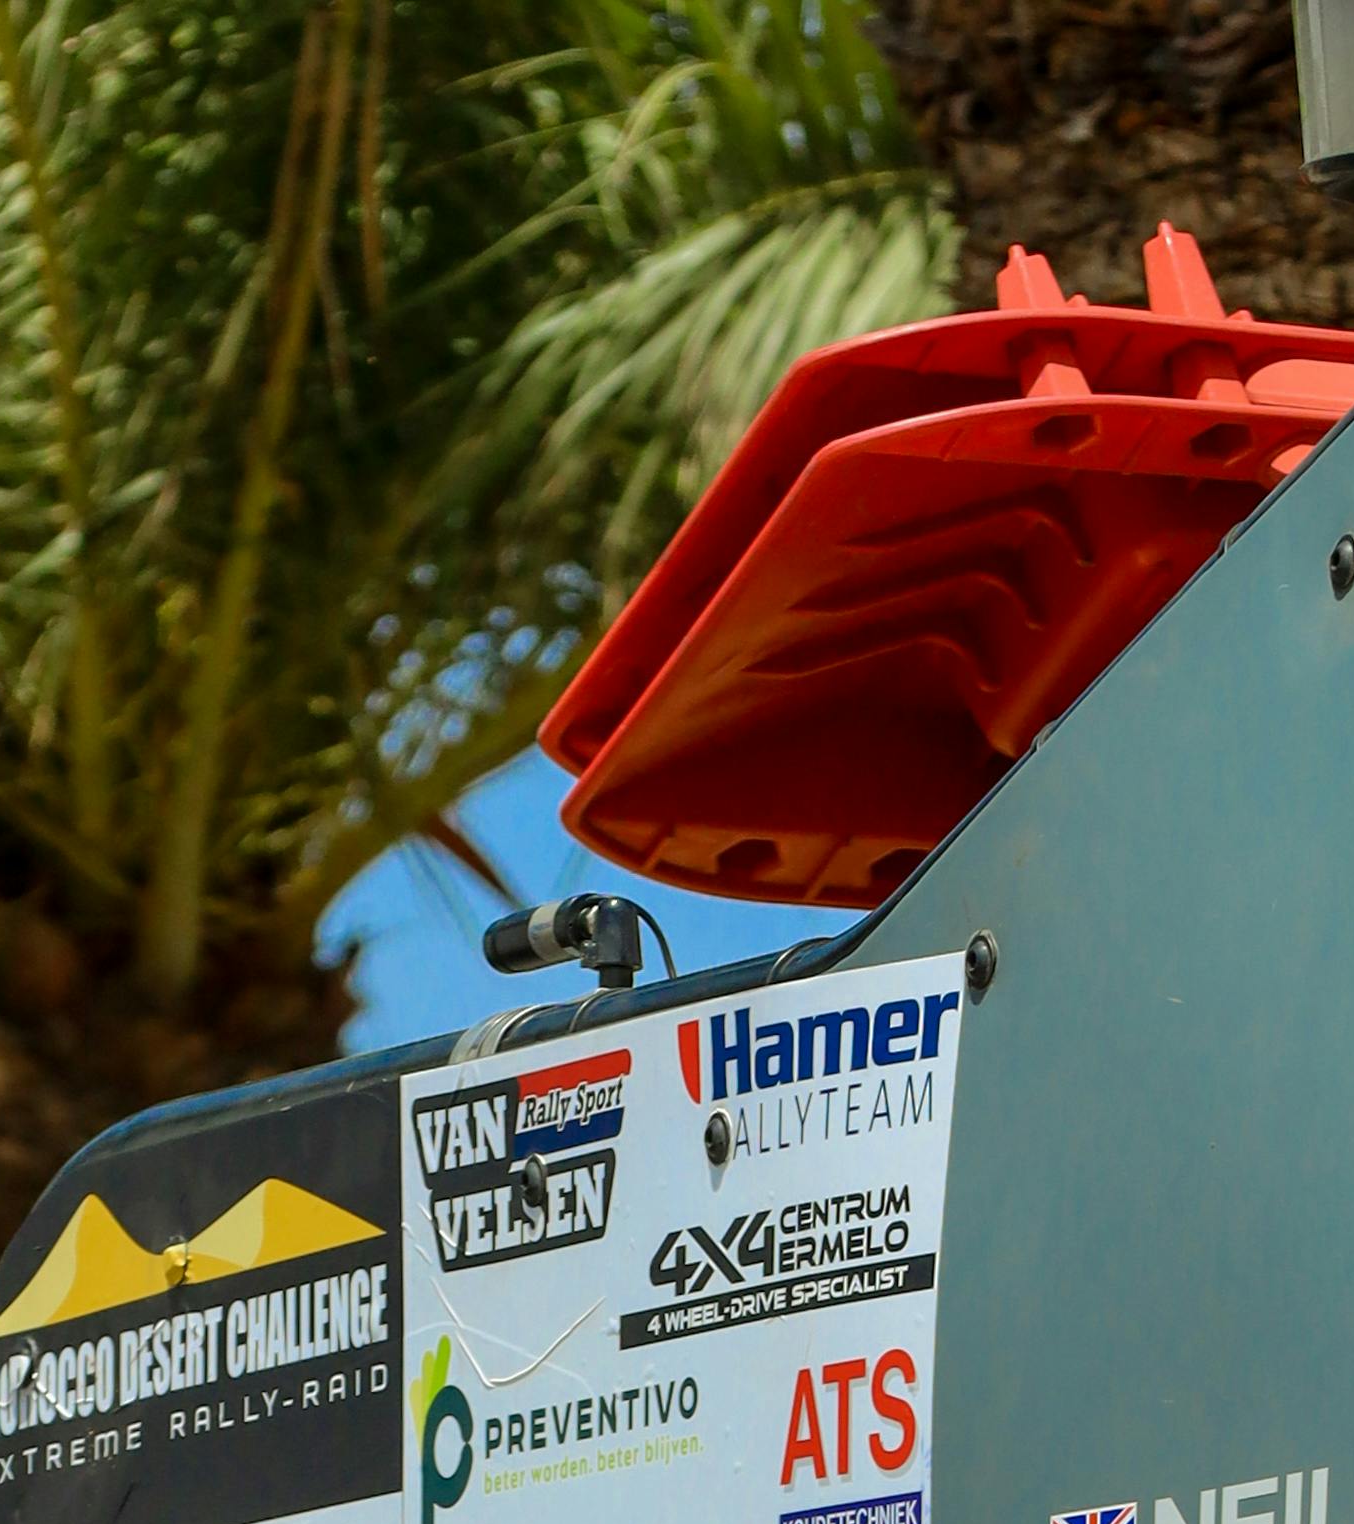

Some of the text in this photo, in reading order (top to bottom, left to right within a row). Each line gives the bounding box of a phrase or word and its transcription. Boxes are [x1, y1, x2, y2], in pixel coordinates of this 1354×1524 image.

[710, 990, 959, 1101] Hamer
[416, 1094, 507, 1174] VAN
[522, 1076, 624, 1131] Rally Sport
[731, 1071, 934, 1161] ALLYTEAM
[434, 1163, 606, 1261] VELSEN
[779, 1220, 909, 1274] ERMELO
[780, 1184, 910, 1234] CENTRUM
[649, 1209, 775, 1297] 4X4
[119, 1305, 224, 1407] DESERT
[226, 1263, 389, 1381] CHALLENGE
[647, 1264, 910, 1336] 4 WHEEL-DRIVE SPECIALIST
[169, 1362, 389, 1440] RALLY-RAID
[485, 1376, 699, 1460] PREVENTIVO
[780, 1348, 917, 1486] ATS
[483, 1434, 704, 1495] beter worden. beter blijven.
